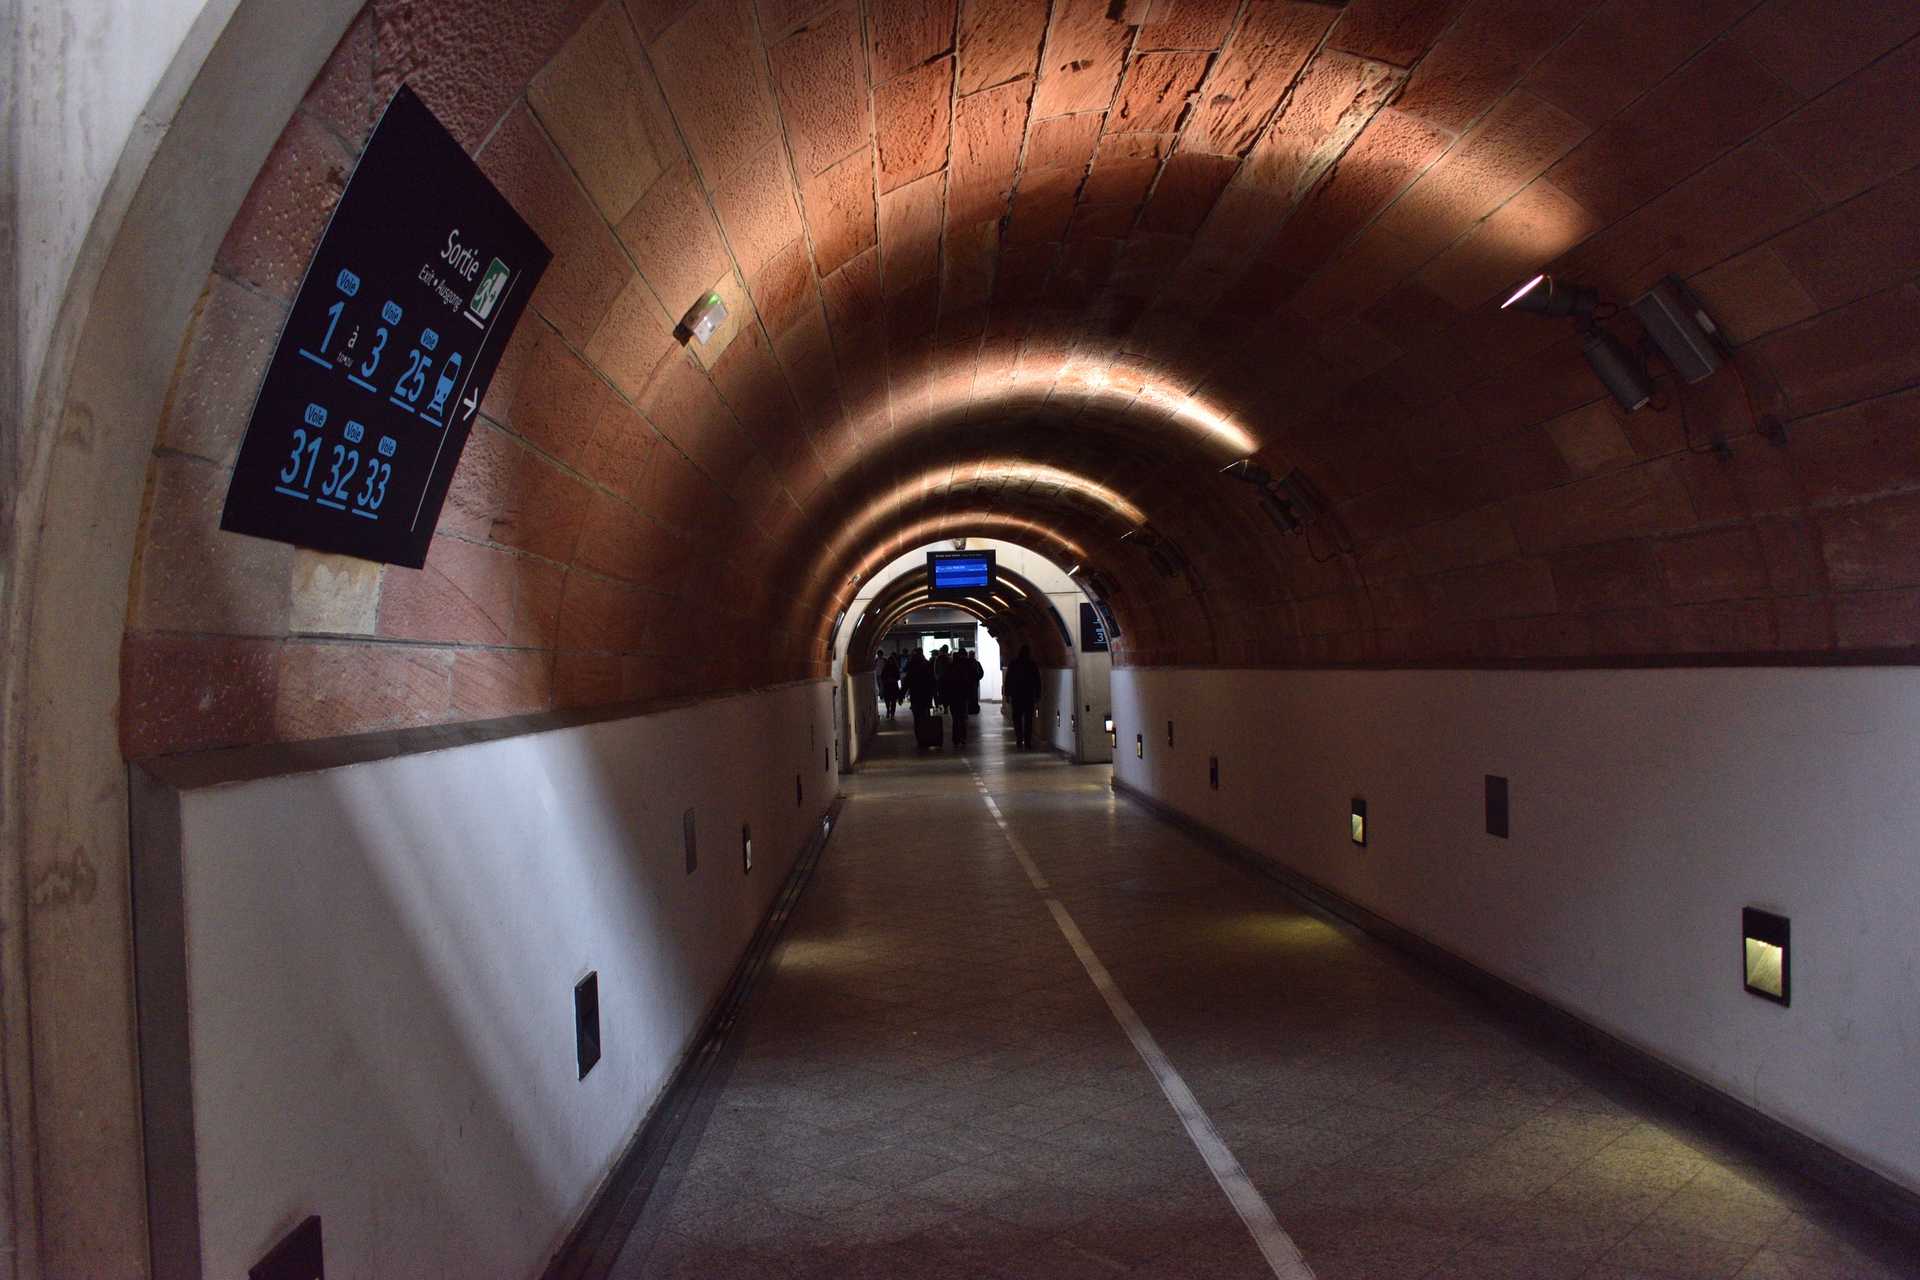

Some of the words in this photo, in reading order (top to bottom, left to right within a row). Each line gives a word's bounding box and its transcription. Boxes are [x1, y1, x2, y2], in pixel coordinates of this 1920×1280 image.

[418, 263, 435, 287] Exit
[440, 228, 480, 282] Sortie
[339, 271, 357, 293] Voie
[384, 303, 400, 322] Voie
[423, 330, 437, 348] Voie
[321, 300, 345, 353] 1
[347, 325, 360, 348] à
[361, 327, 388, 378] 3
[394, 349, 432, 403] 25
[308, 405, 325, 426] Voie
[347, 423, 362, 442] Voie
[380, 438, 395, 456] Voie
[280, 428, 322, 489] 31
[322, 444, 359, 500] 32
[357, 458, 391, 509] 33
